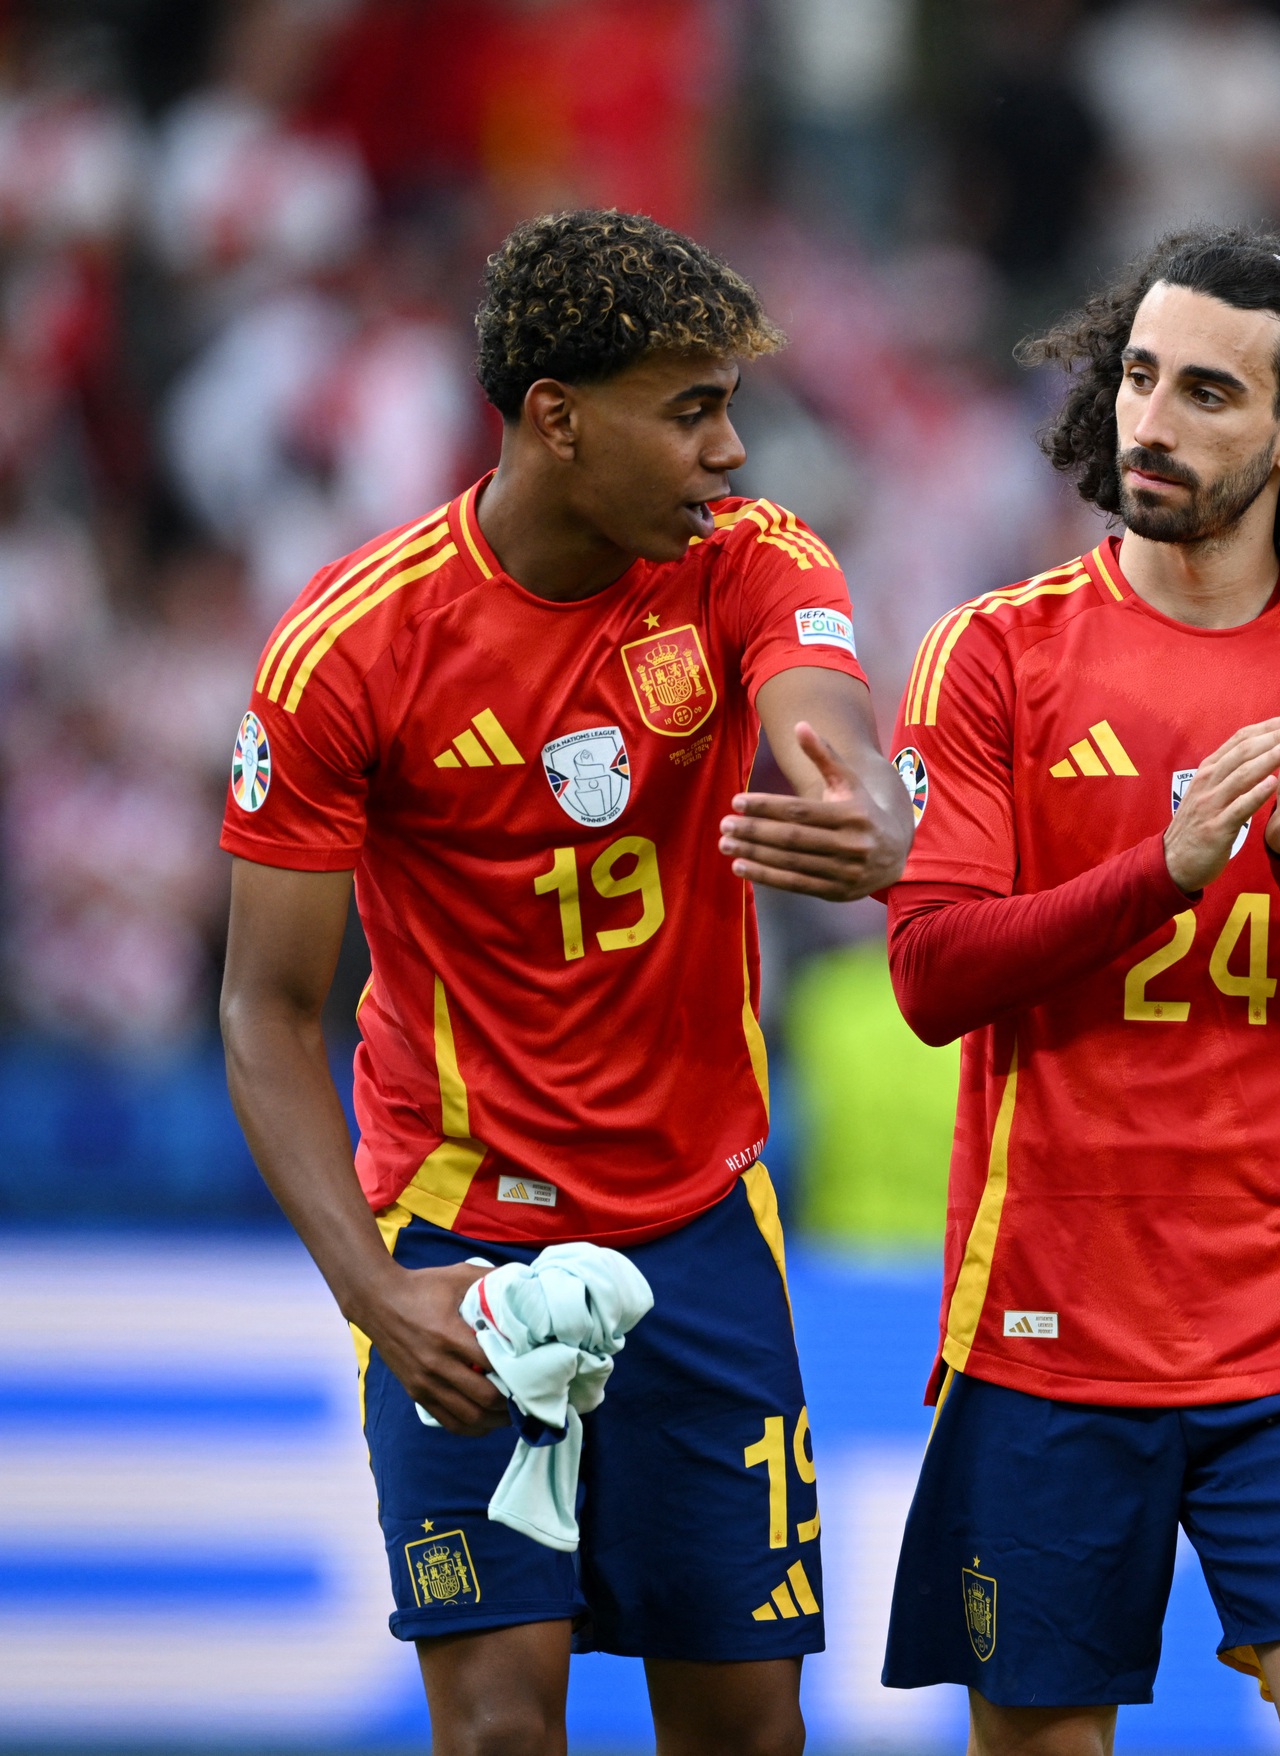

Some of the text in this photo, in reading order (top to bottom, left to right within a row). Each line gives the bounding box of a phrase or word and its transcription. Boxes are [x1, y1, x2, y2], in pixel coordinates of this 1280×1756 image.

[799, 610, 826, 620] UEFA
[545, 729, 616, 753] UEFA NATIONS LEAGUE
[581, 807, 621, 823] WINNER 2023
[533, 836, 666, 961] 19
[1123, 892, 1278, 1026] 24
[725, 1137, 764, 1172] HEAT.RDY
